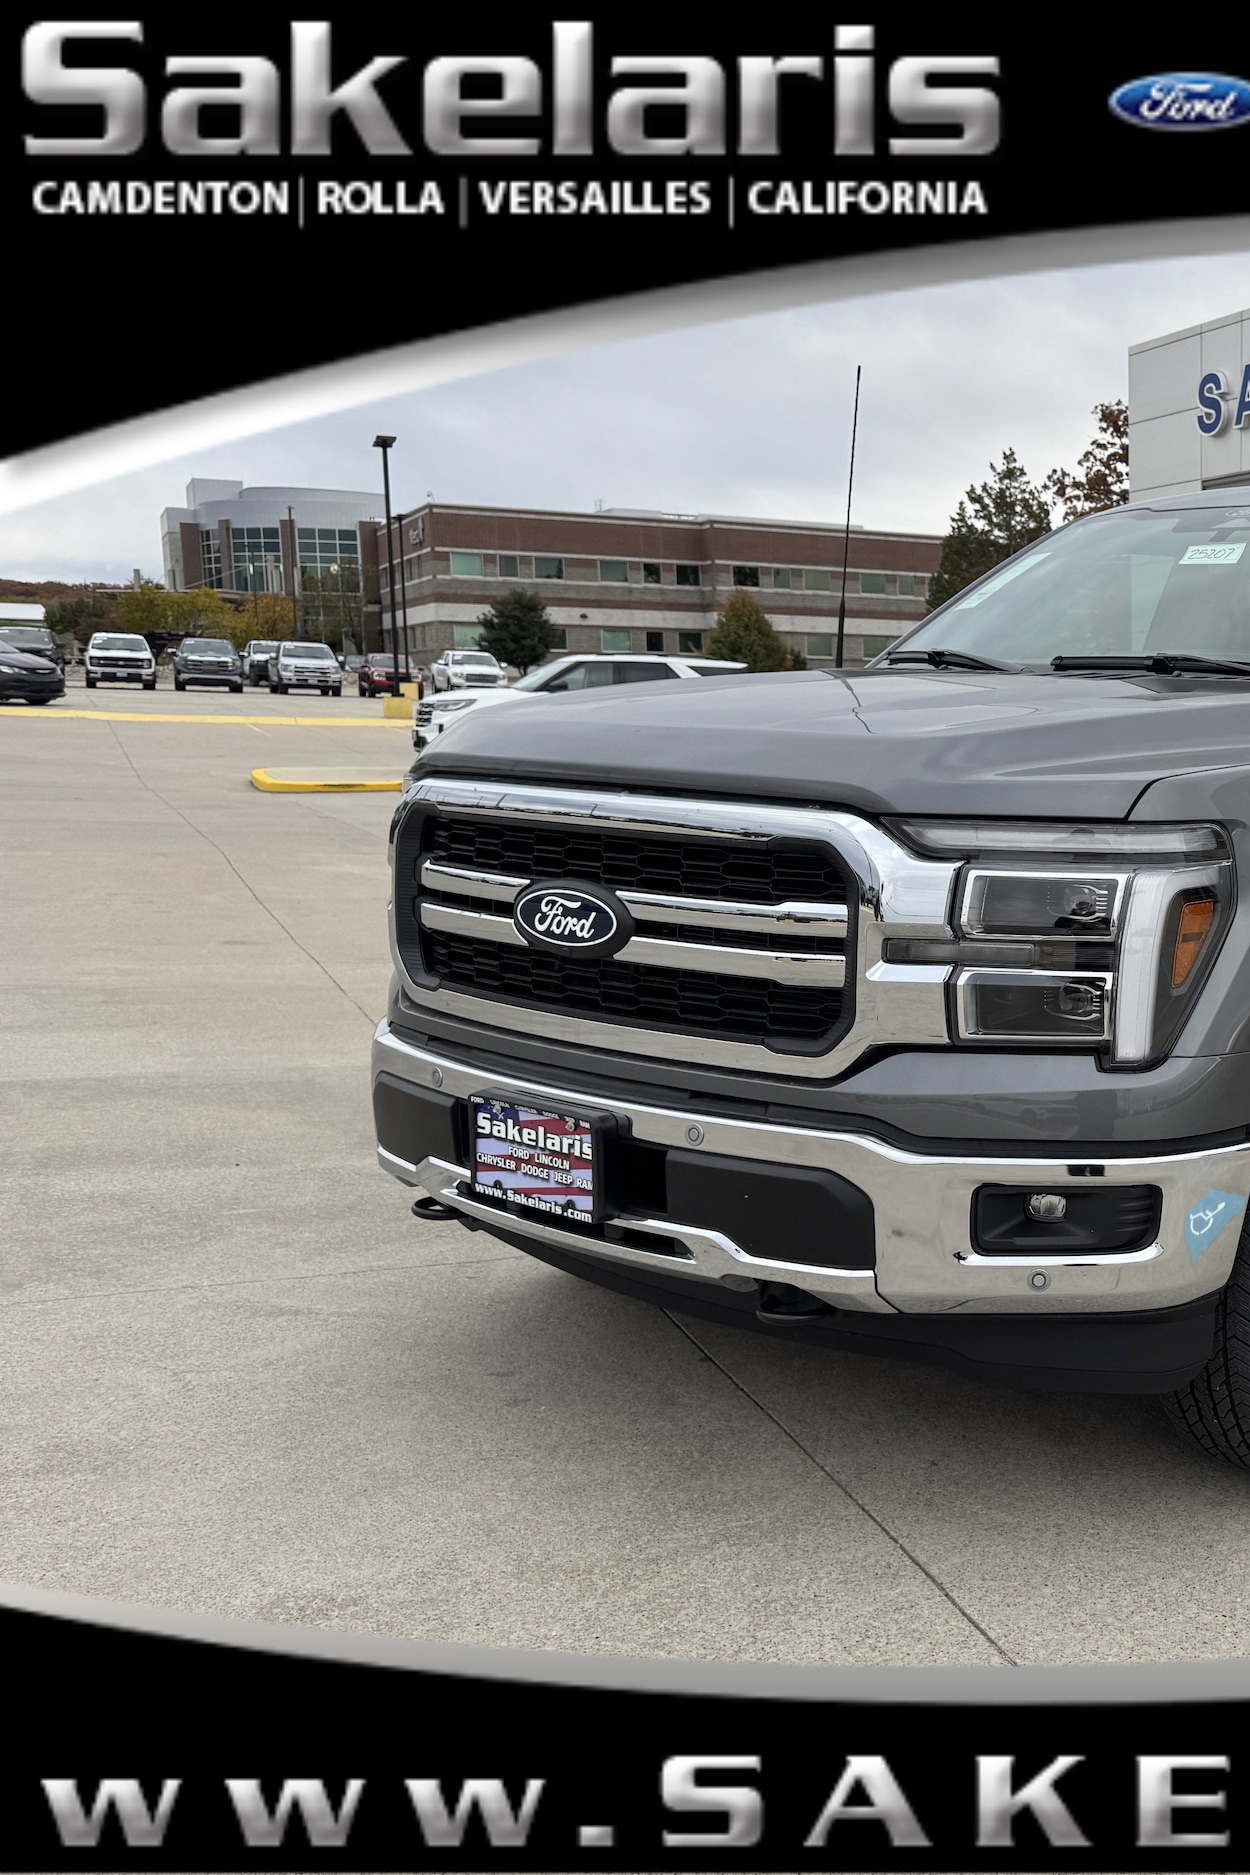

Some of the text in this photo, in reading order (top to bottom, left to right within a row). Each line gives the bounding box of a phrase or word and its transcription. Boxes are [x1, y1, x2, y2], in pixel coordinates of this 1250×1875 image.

[1187, 547, 1236, 560] 25207
[534, 896, 597, 939] Ford
[476, 1112, 593, 1160] Sakelaris
[476, 1152, 517, 1170] CHRYSLER
[521, 1163, 549, 1179] DODGE
[554, 1171, 573, 1185] JEEP
[508, 1146, 570, 1170] FORD LINCOLN
